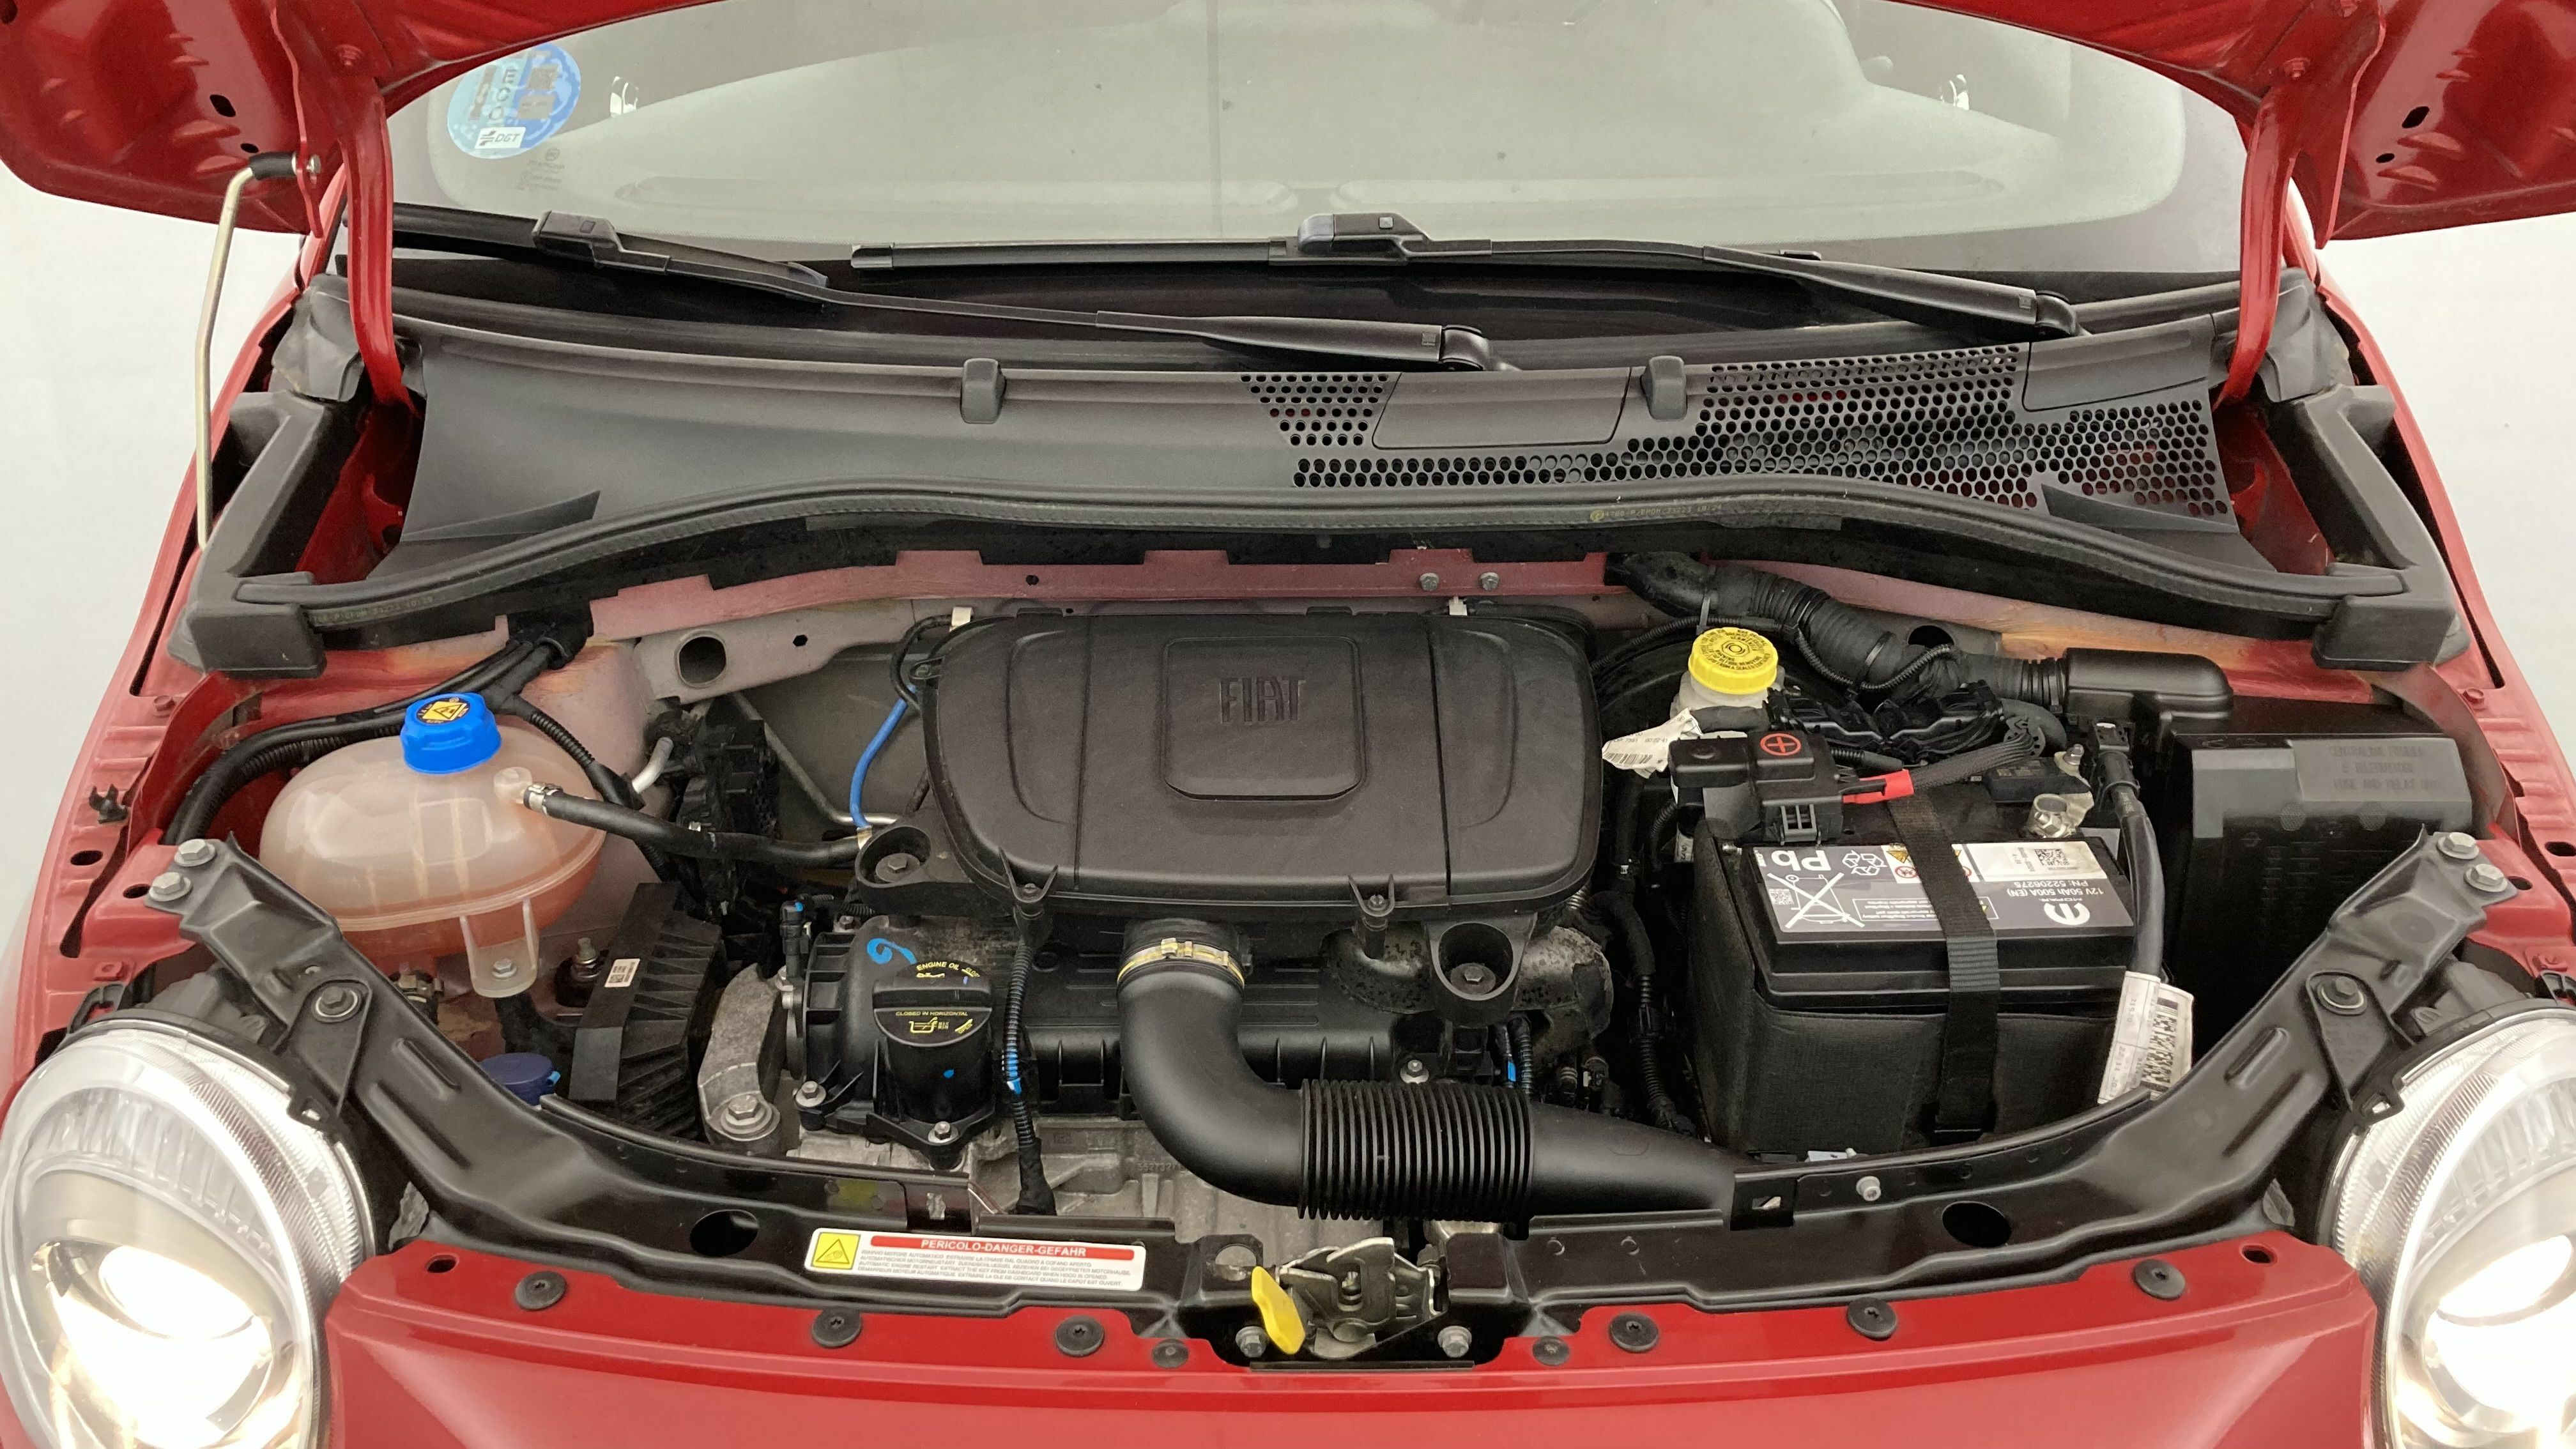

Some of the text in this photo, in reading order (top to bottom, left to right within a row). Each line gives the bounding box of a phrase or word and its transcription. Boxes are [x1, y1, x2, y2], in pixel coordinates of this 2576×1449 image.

[494, 133, 521, 143] DGT
[1219, 677, 1307, 724] FIAT
[1771, 850, 1832, 871] Pb
[2007, 888, 2028, 897] (EN)
[2057, 887, 2083, 896] 50Ah
[916, 961, 960, 971] ENGINE OIL
[920, 1238, 1086, 1257] PERICOLO-DANGER-GEFAHR
